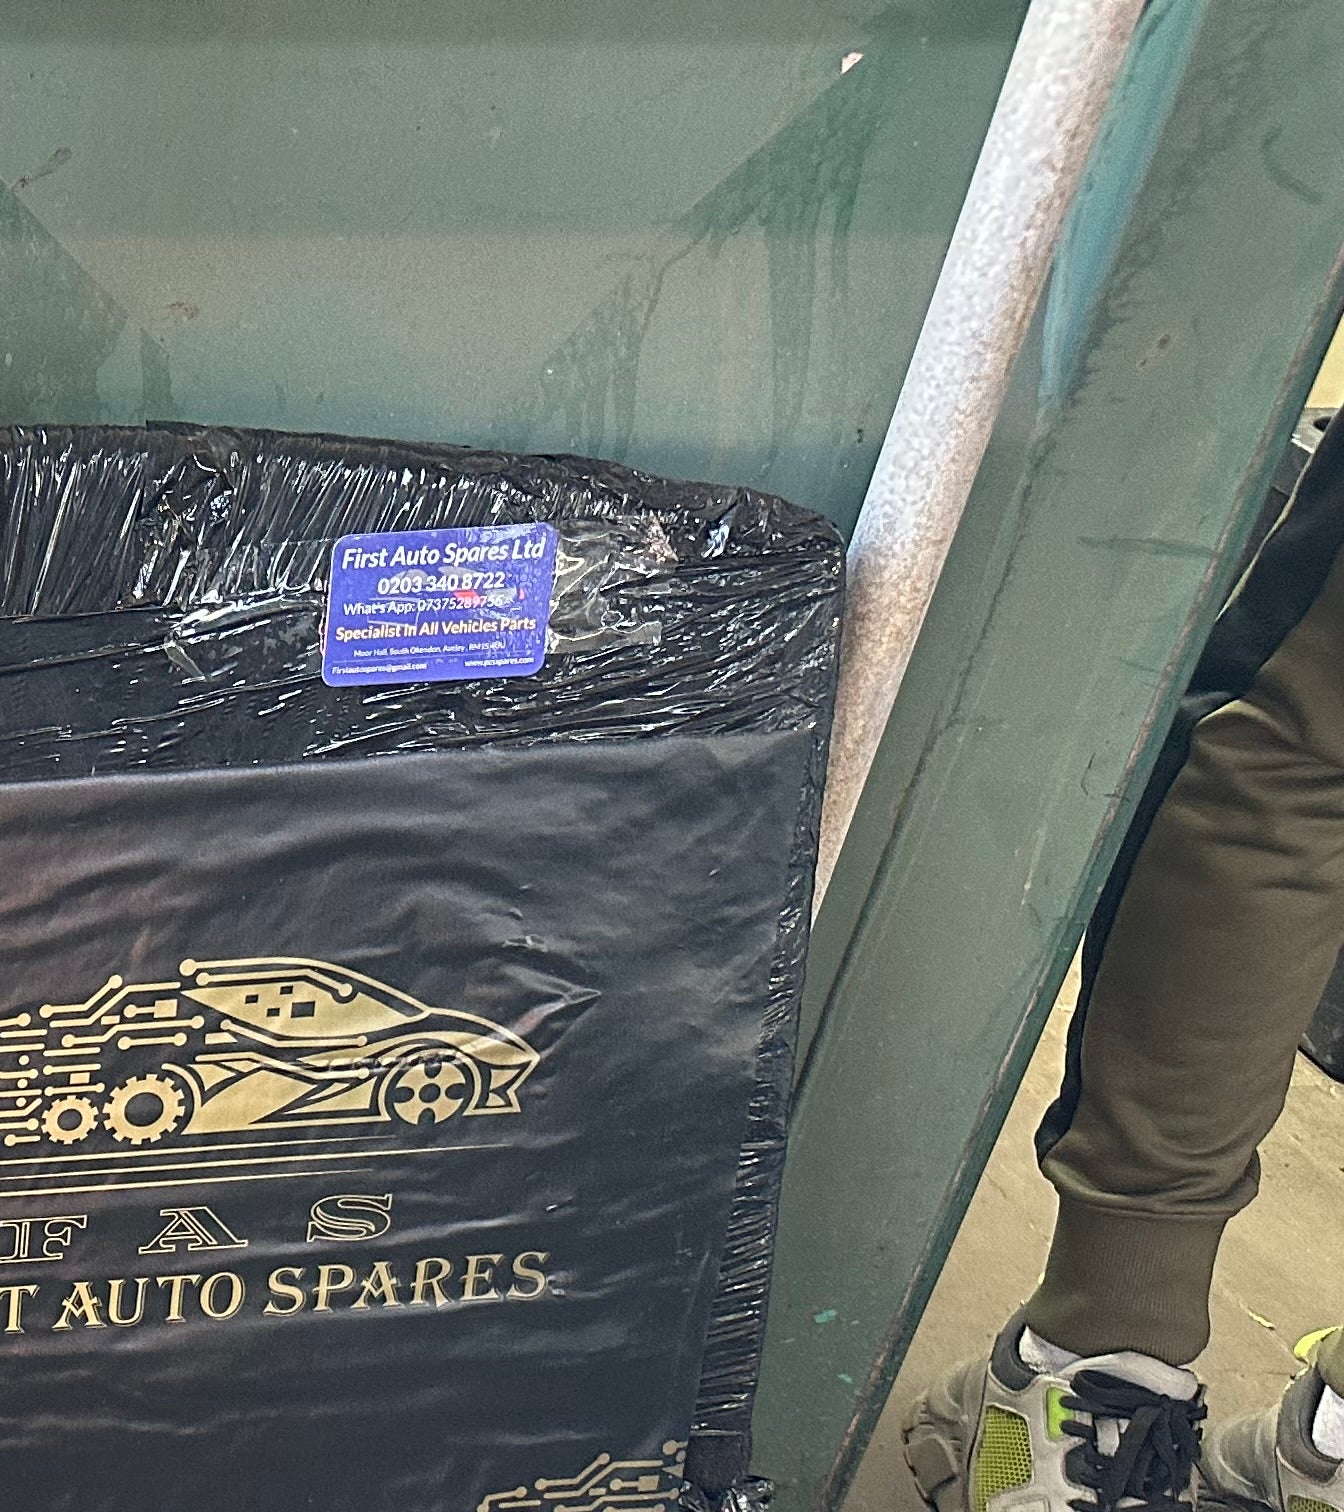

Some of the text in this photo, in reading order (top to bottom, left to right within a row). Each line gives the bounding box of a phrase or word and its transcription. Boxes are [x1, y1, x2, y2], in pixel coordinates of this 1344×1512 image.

[342, 535, 547, 569] First Auto Spares Ltd
[377, 571, 506, 595] 0203 340 8722
[343, 602, 386, 616] What's
[335, 623, 401, 643] Specialist
[418, 621, 439, 636] All
[441, 619, 498, 635] Vehicles
[500, 617, 537, 631] Parts
[52, 1271, 246, 1332] AUTO
[263, 1250, 553, 1318] SPARES
